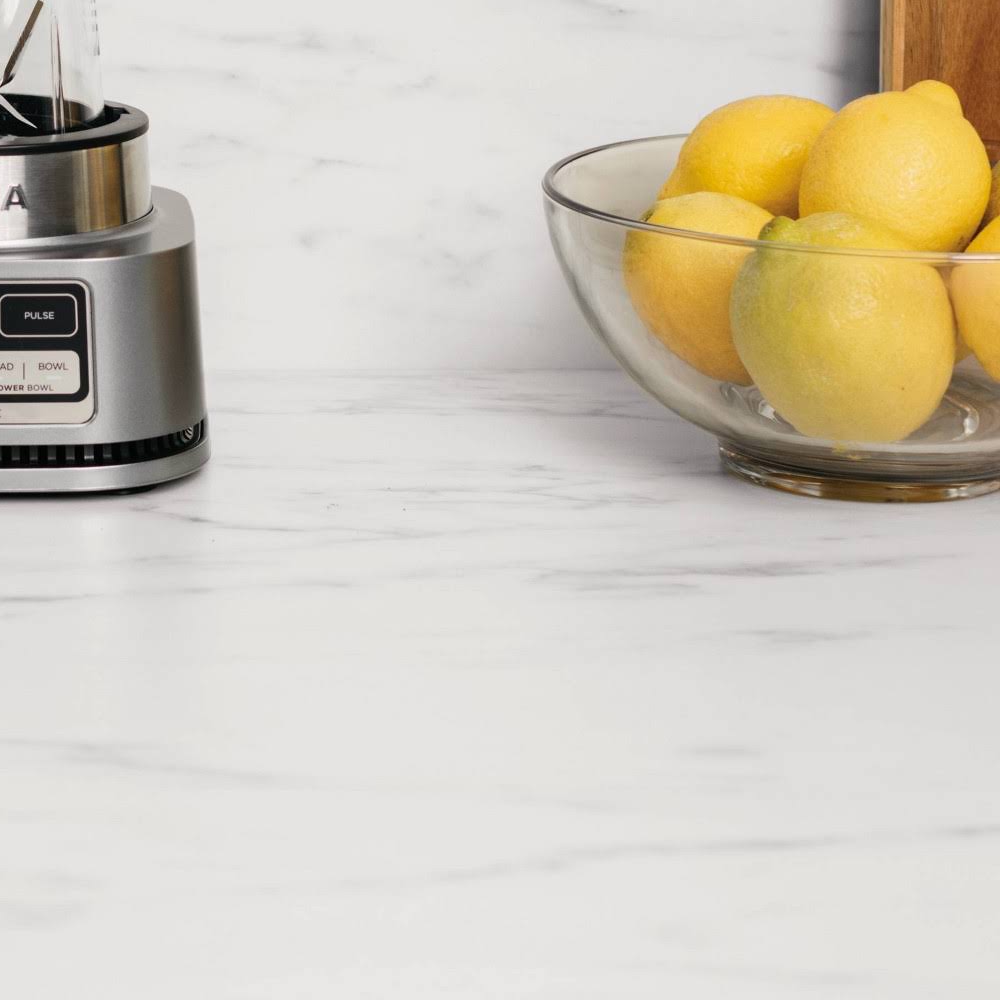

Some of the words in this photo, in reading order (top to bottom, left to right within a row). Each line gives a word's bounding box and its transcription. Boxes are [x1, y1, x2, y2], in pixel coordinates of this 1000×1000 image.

[24, 311, 55, 320] PULSE
[38, 362, 69, 371] BOWL
[27, 384, 54, 392] BOWL
